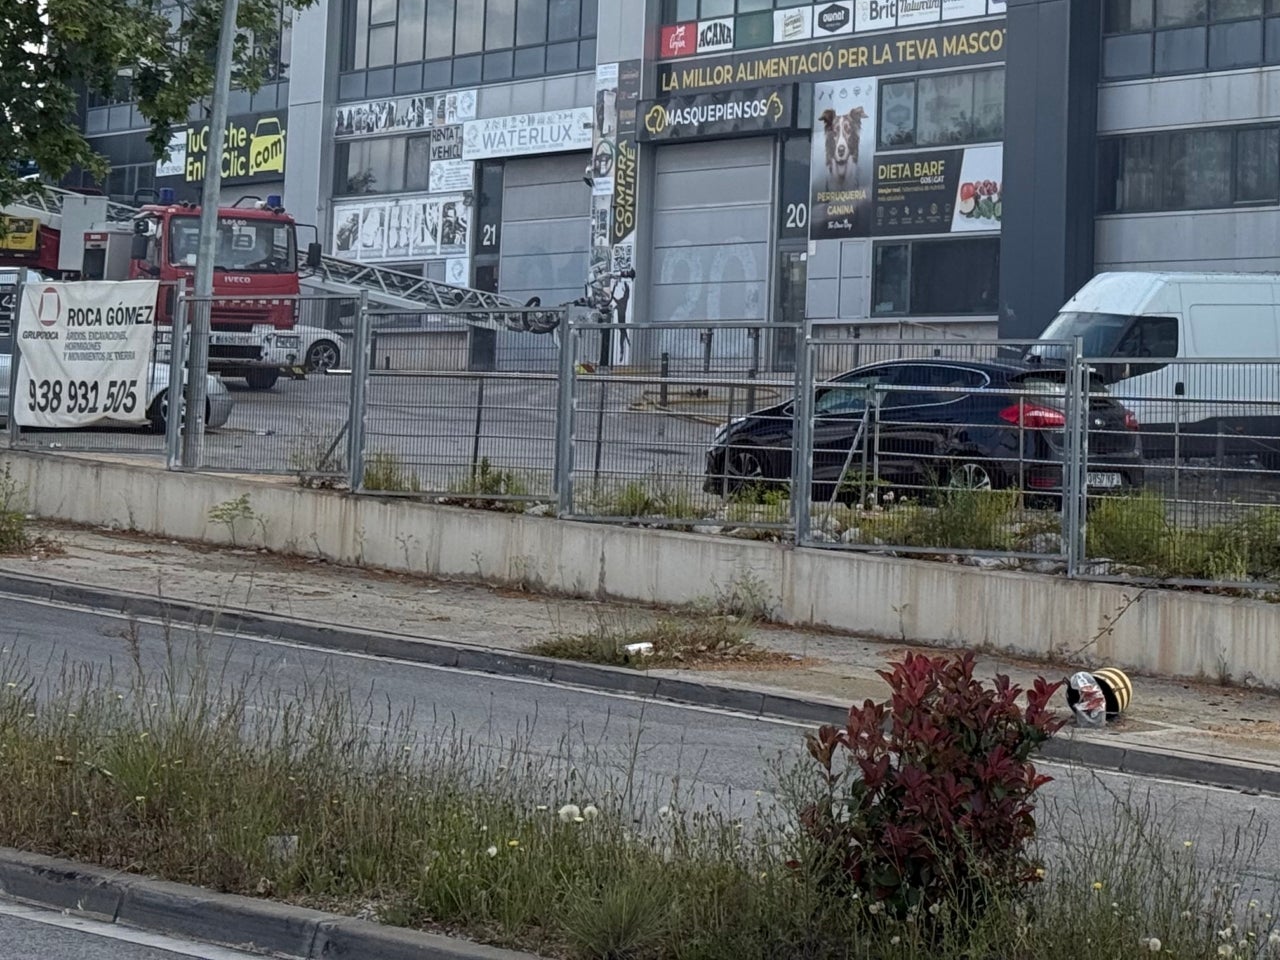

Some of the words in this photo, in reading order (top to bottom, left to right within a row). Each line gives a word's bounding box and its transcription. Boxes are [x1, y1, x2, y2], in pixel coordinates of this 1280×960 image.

[698, 22, 732, 48] ACANA
[661, 71, 679, 92] LA
[682, 64, 732, 89] MILLOR
[736, 45, 834, 81] ALIMENTACIÓ
[837, 46, 868, 70] PER
[872, 43, 893, 65] LA
[896, 38, 938, 62] TEVA
[942, 28, 1007, 57] MASCO
[187, 122, 247, 153] TuCche
[482, 123, 573, 150] WATERLUX
[878, 162, 912, 179] DIETA
[913, 160, 946, 177] BARF
[615, 139, 628, 238] COMPRA
[623, 147, 636, 229] ONLINE
[786, 203, 806, 228] 20
[826, 204, 855, 216] CANINA
[482, 223, 497, 246] 21
[223, 275, 252, 284] IVECO
[66, 307, 103, 327] ROCA
[106, 301, 154, 327] GÓMEZ
[28, 378, 63, 414] 938
[66, 380, 100, 414] 931
[102, 379, 138, 414] 505
